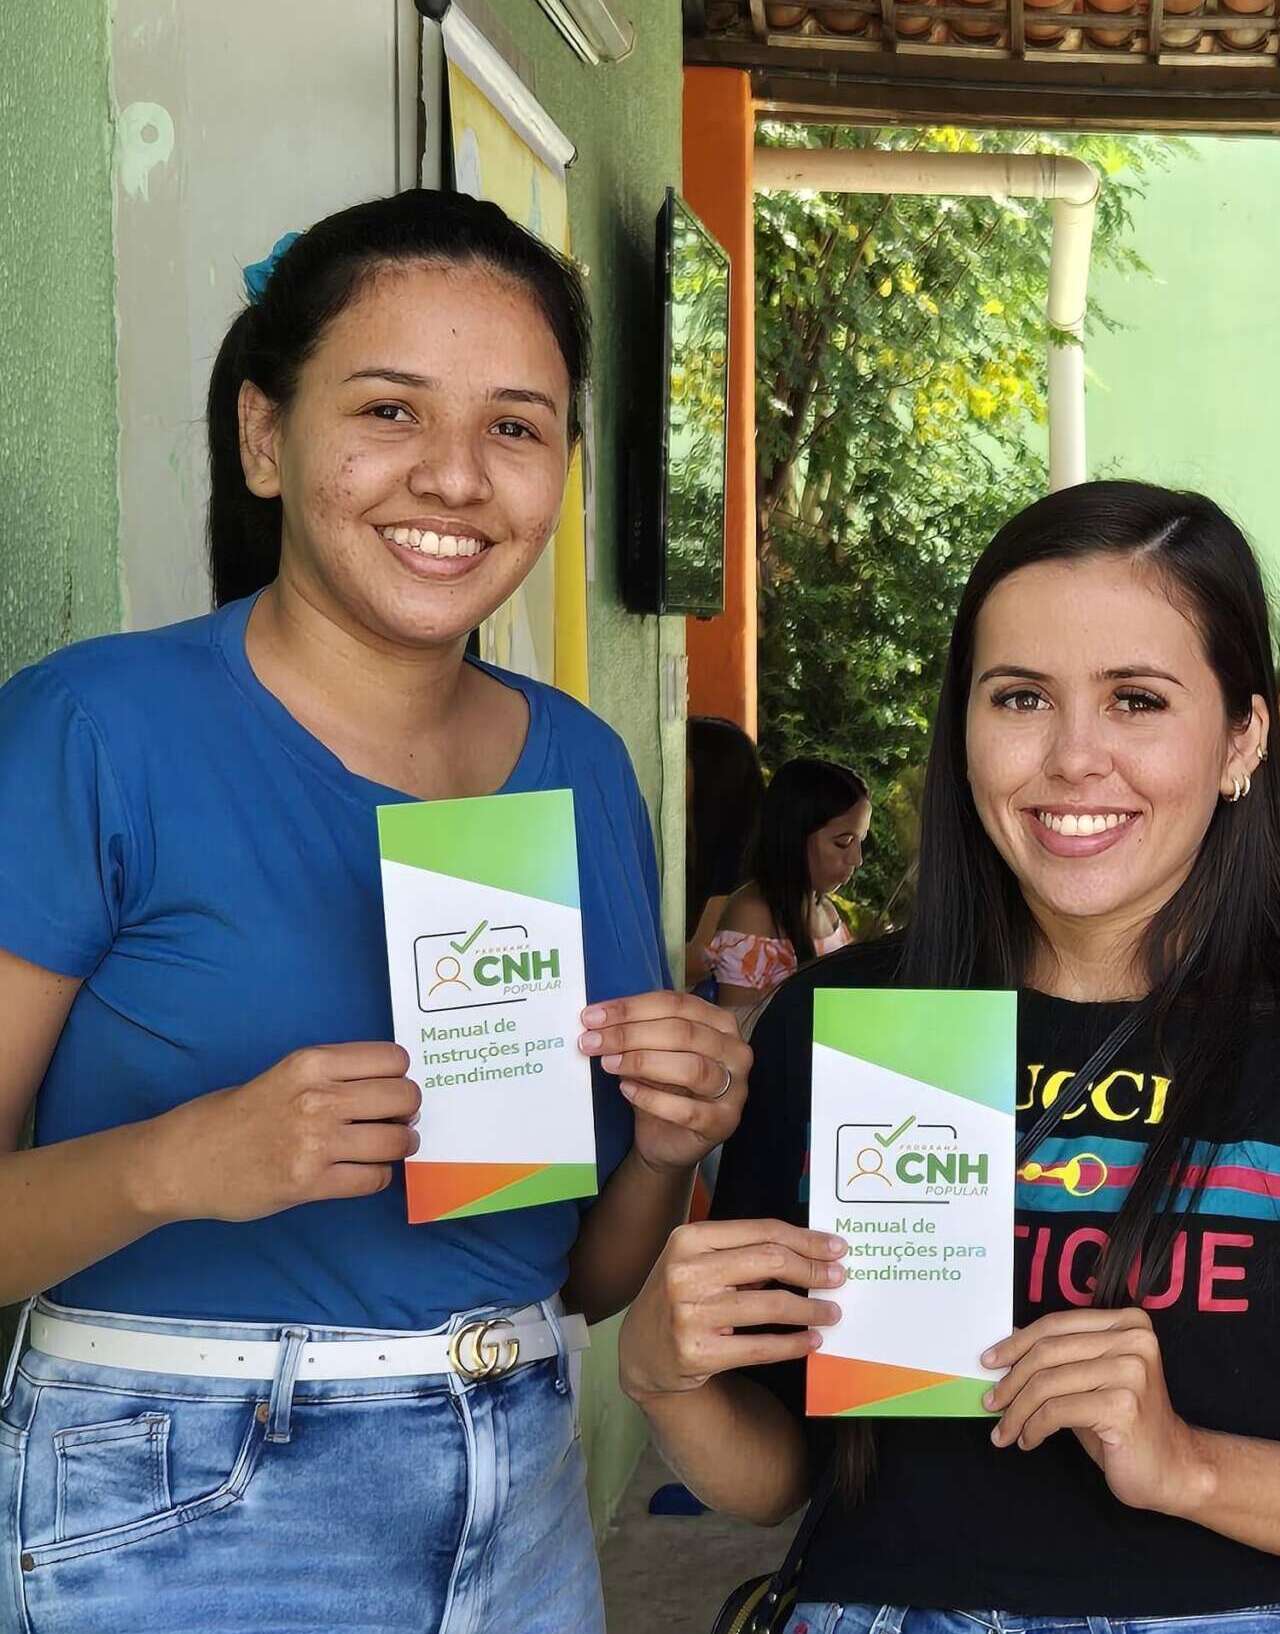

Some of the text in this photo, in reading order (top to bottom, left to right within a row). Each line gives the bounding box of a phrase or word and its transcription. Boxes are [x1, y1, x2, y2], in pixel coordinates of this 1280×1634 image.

[473, 949, 560, 986] CNH
[503, 980, 562, 996] POPULAR
[421, 1018, 517, 1043] Manual de
[423, 1036, 565, 1065] instruções para
[424, 1061, 544, 1089] atendimento
[895, 1152, 989, 1184] CNH
[925, 1186, 989, 1196] POPULAR
[835, 1217, 937, 1233] Manual de
[847, 1241, 987, 1262] nstruções para
[846, 1265, 962, 1281] tendimento
